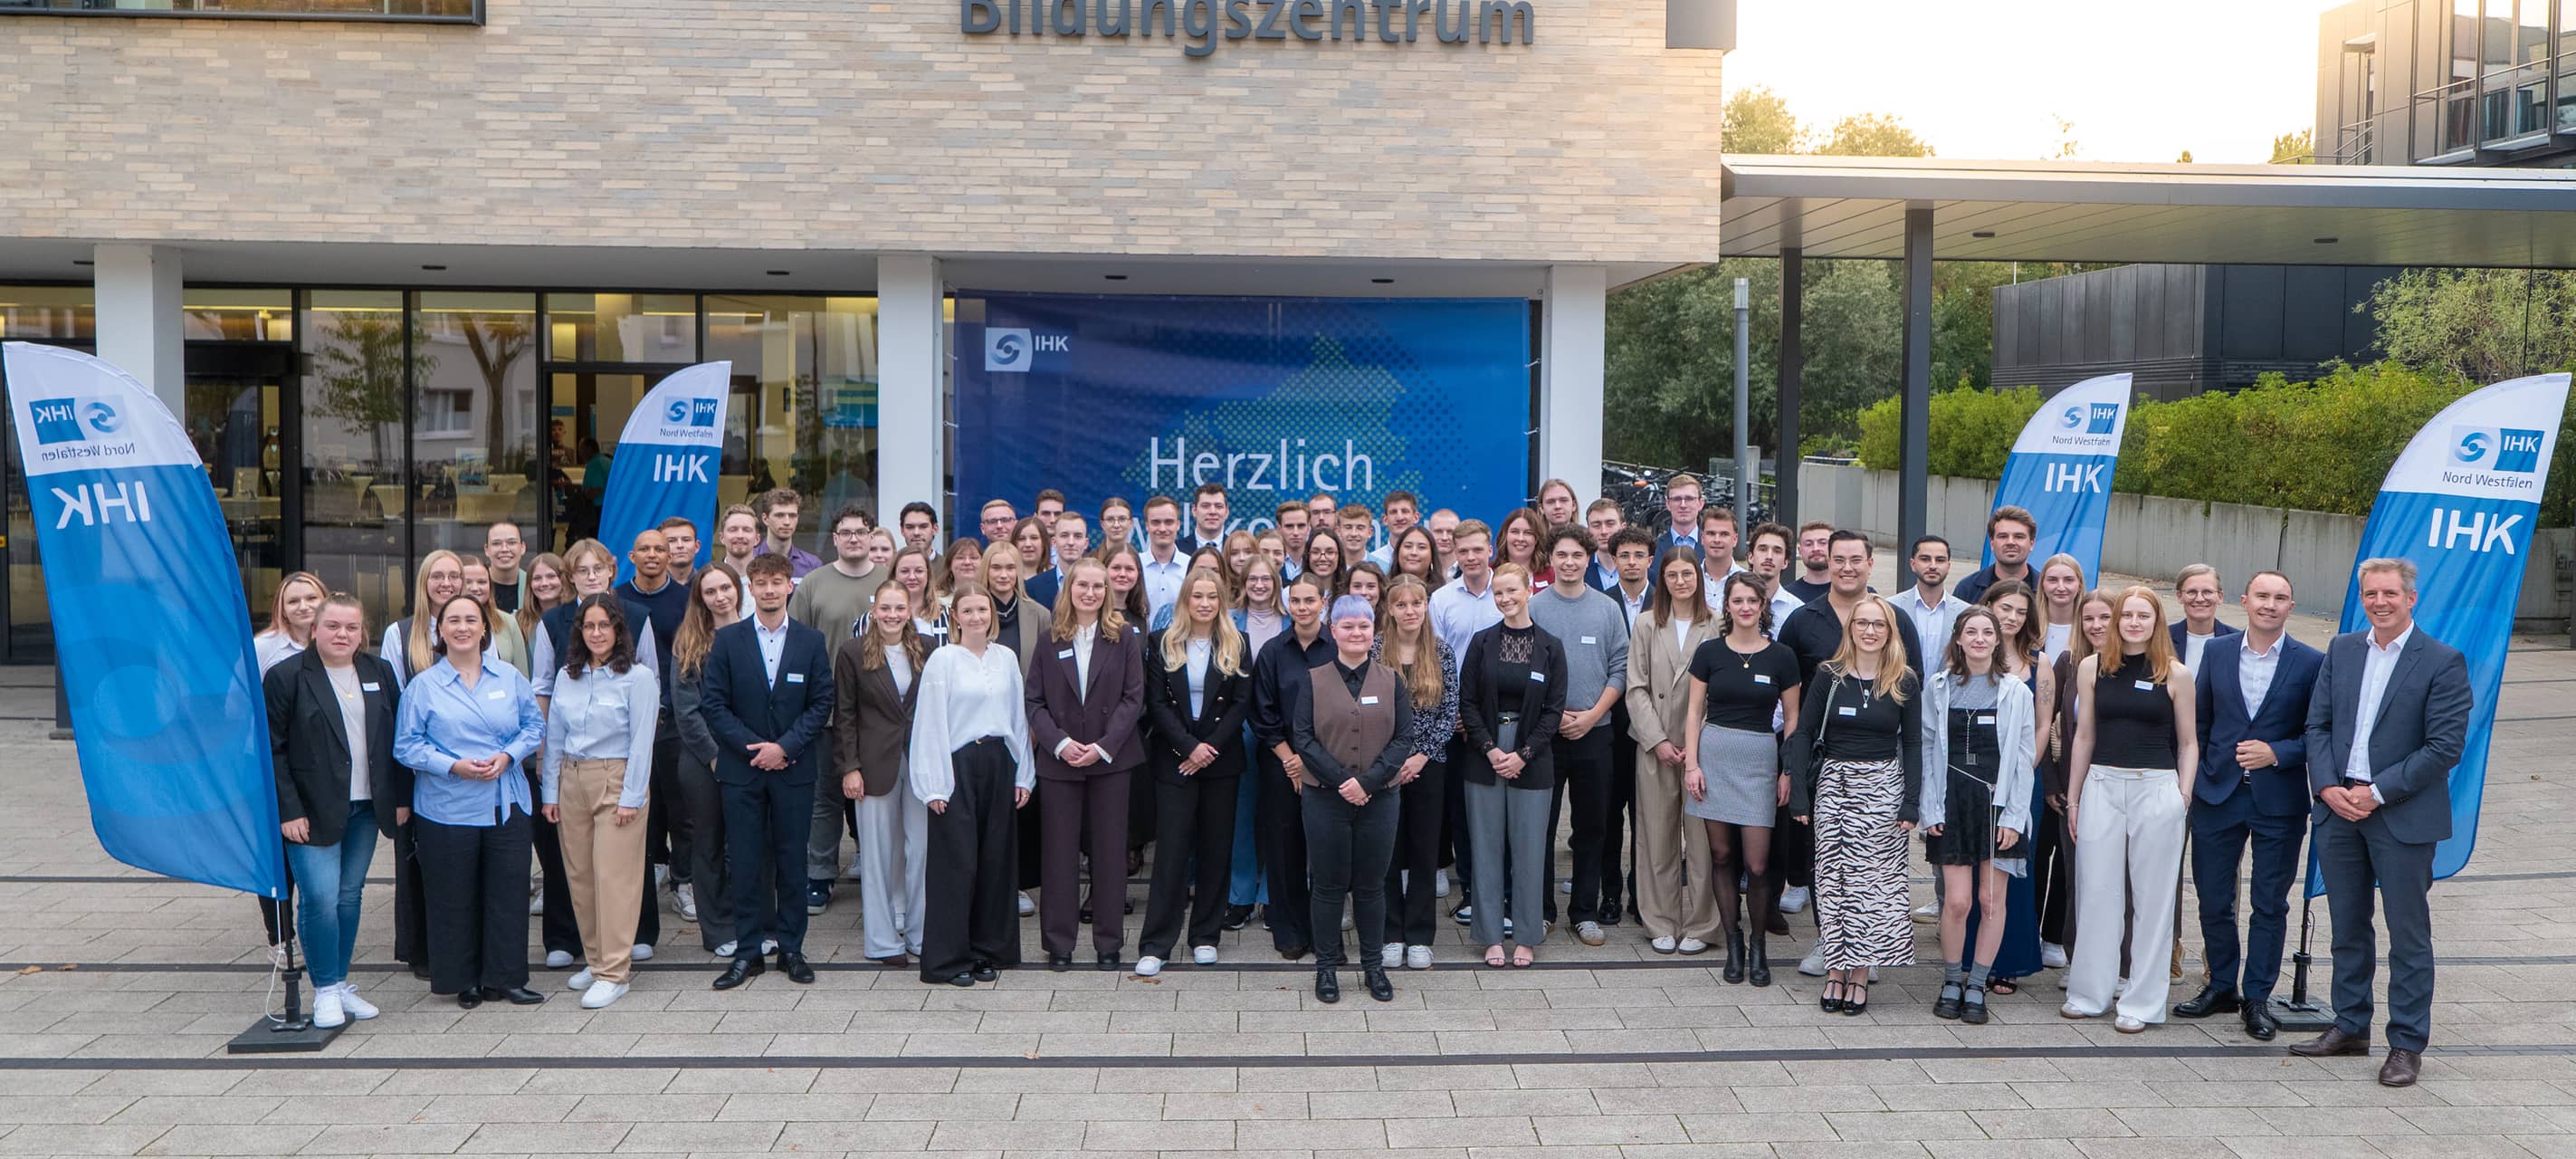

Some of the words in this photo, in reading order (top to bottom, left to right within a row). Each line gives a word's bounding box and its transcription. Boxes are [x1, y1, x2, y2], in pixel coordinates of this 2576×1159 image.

[961, 0, 1535, 57] Bildungszentrum
[1035, 335, 1069, 352] IHK
[695, 402, 716, 414] IHK
[2093, 407, 2116, 420] IHK
[659, 427, 679, 437] Nord
[2052, 435, 2073, 445] Nord
[2504, 435, 2540, 453] IHK
[654, 454, 710, 484] IHK
[1150, 436, 1372, 493] Herzlich
[2044, 463, 2105, 493] IHK
[2442, 471, 2473, 484] Nord
[2428, 508, 2524, 555] IHK
